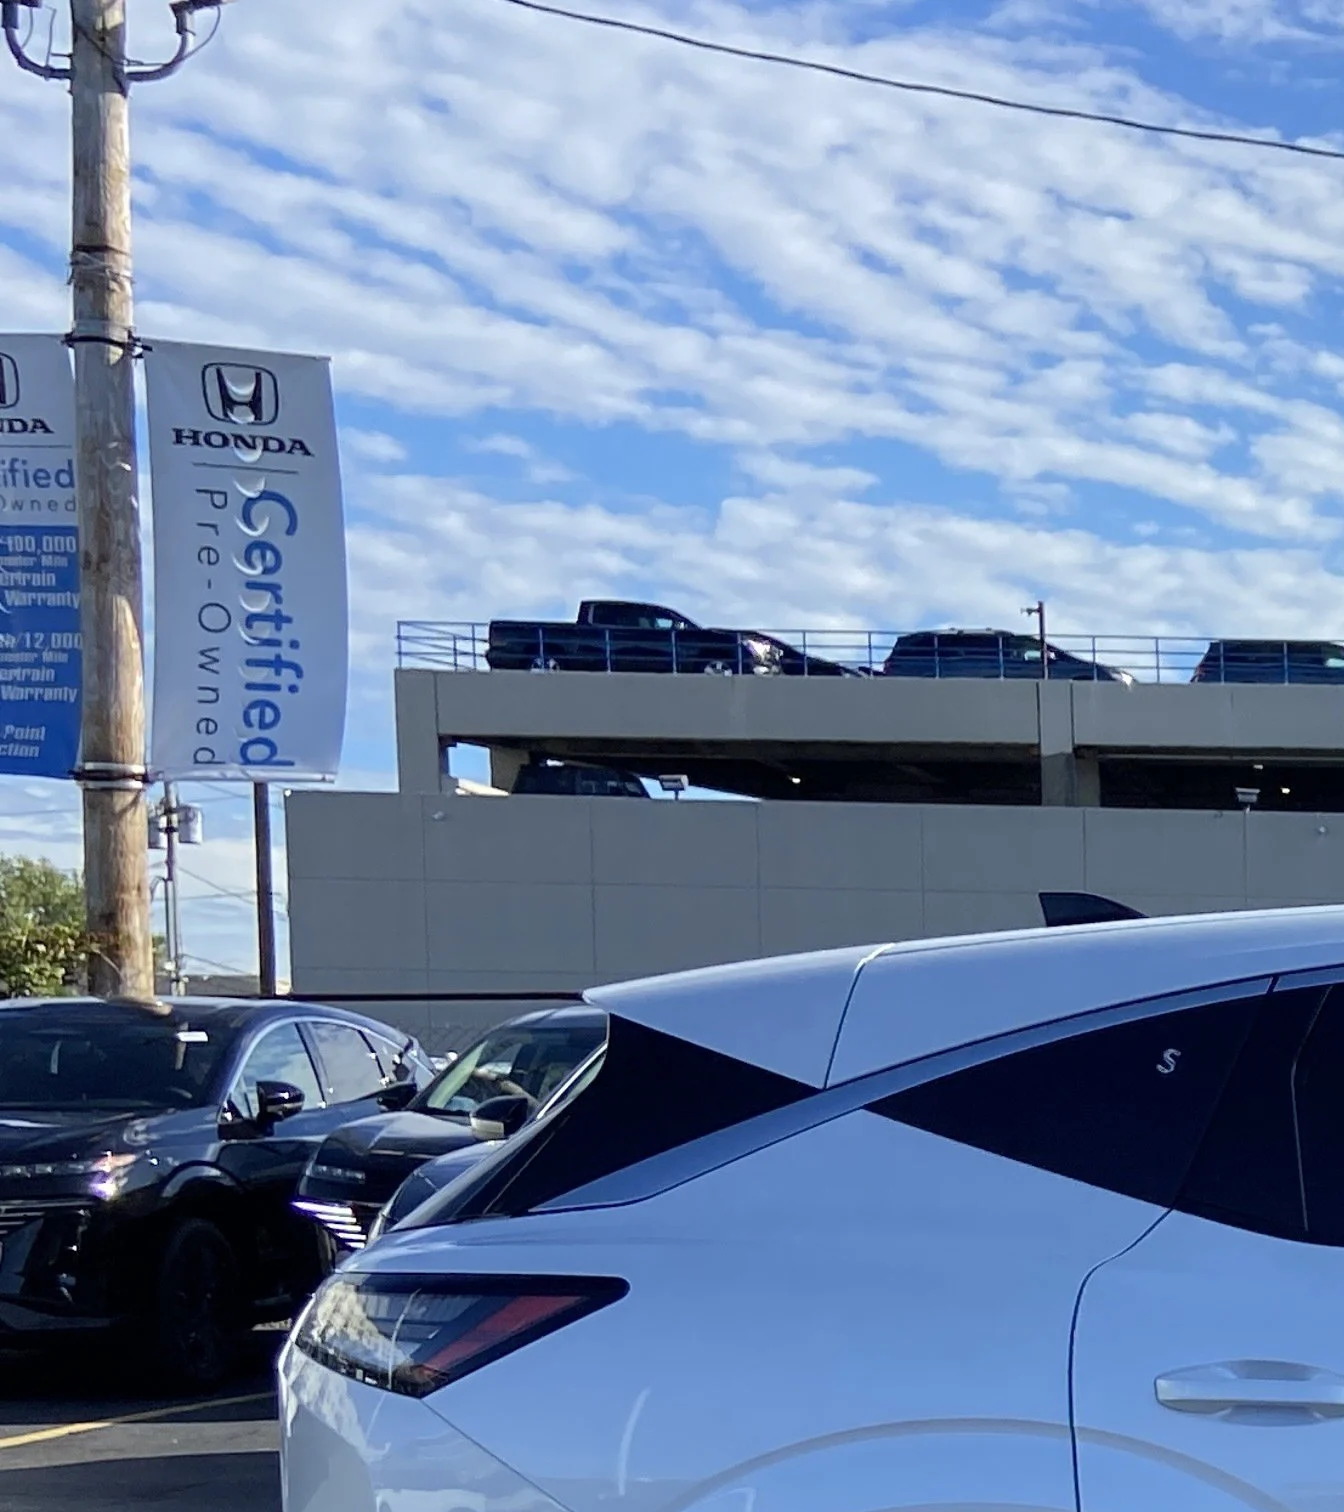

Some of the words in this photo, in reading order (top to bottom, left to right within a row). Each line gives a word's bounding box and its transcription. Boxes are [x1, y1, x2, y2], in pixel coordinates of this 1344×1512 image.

[172, 428, 314, 457] HONDA
[4, 590, 80, 609] Warranty
[193, 488, 232, 765] Pre-Owned
[240, 489, 304, 767] Certified
[1, 685, 78, 702] Warranty
